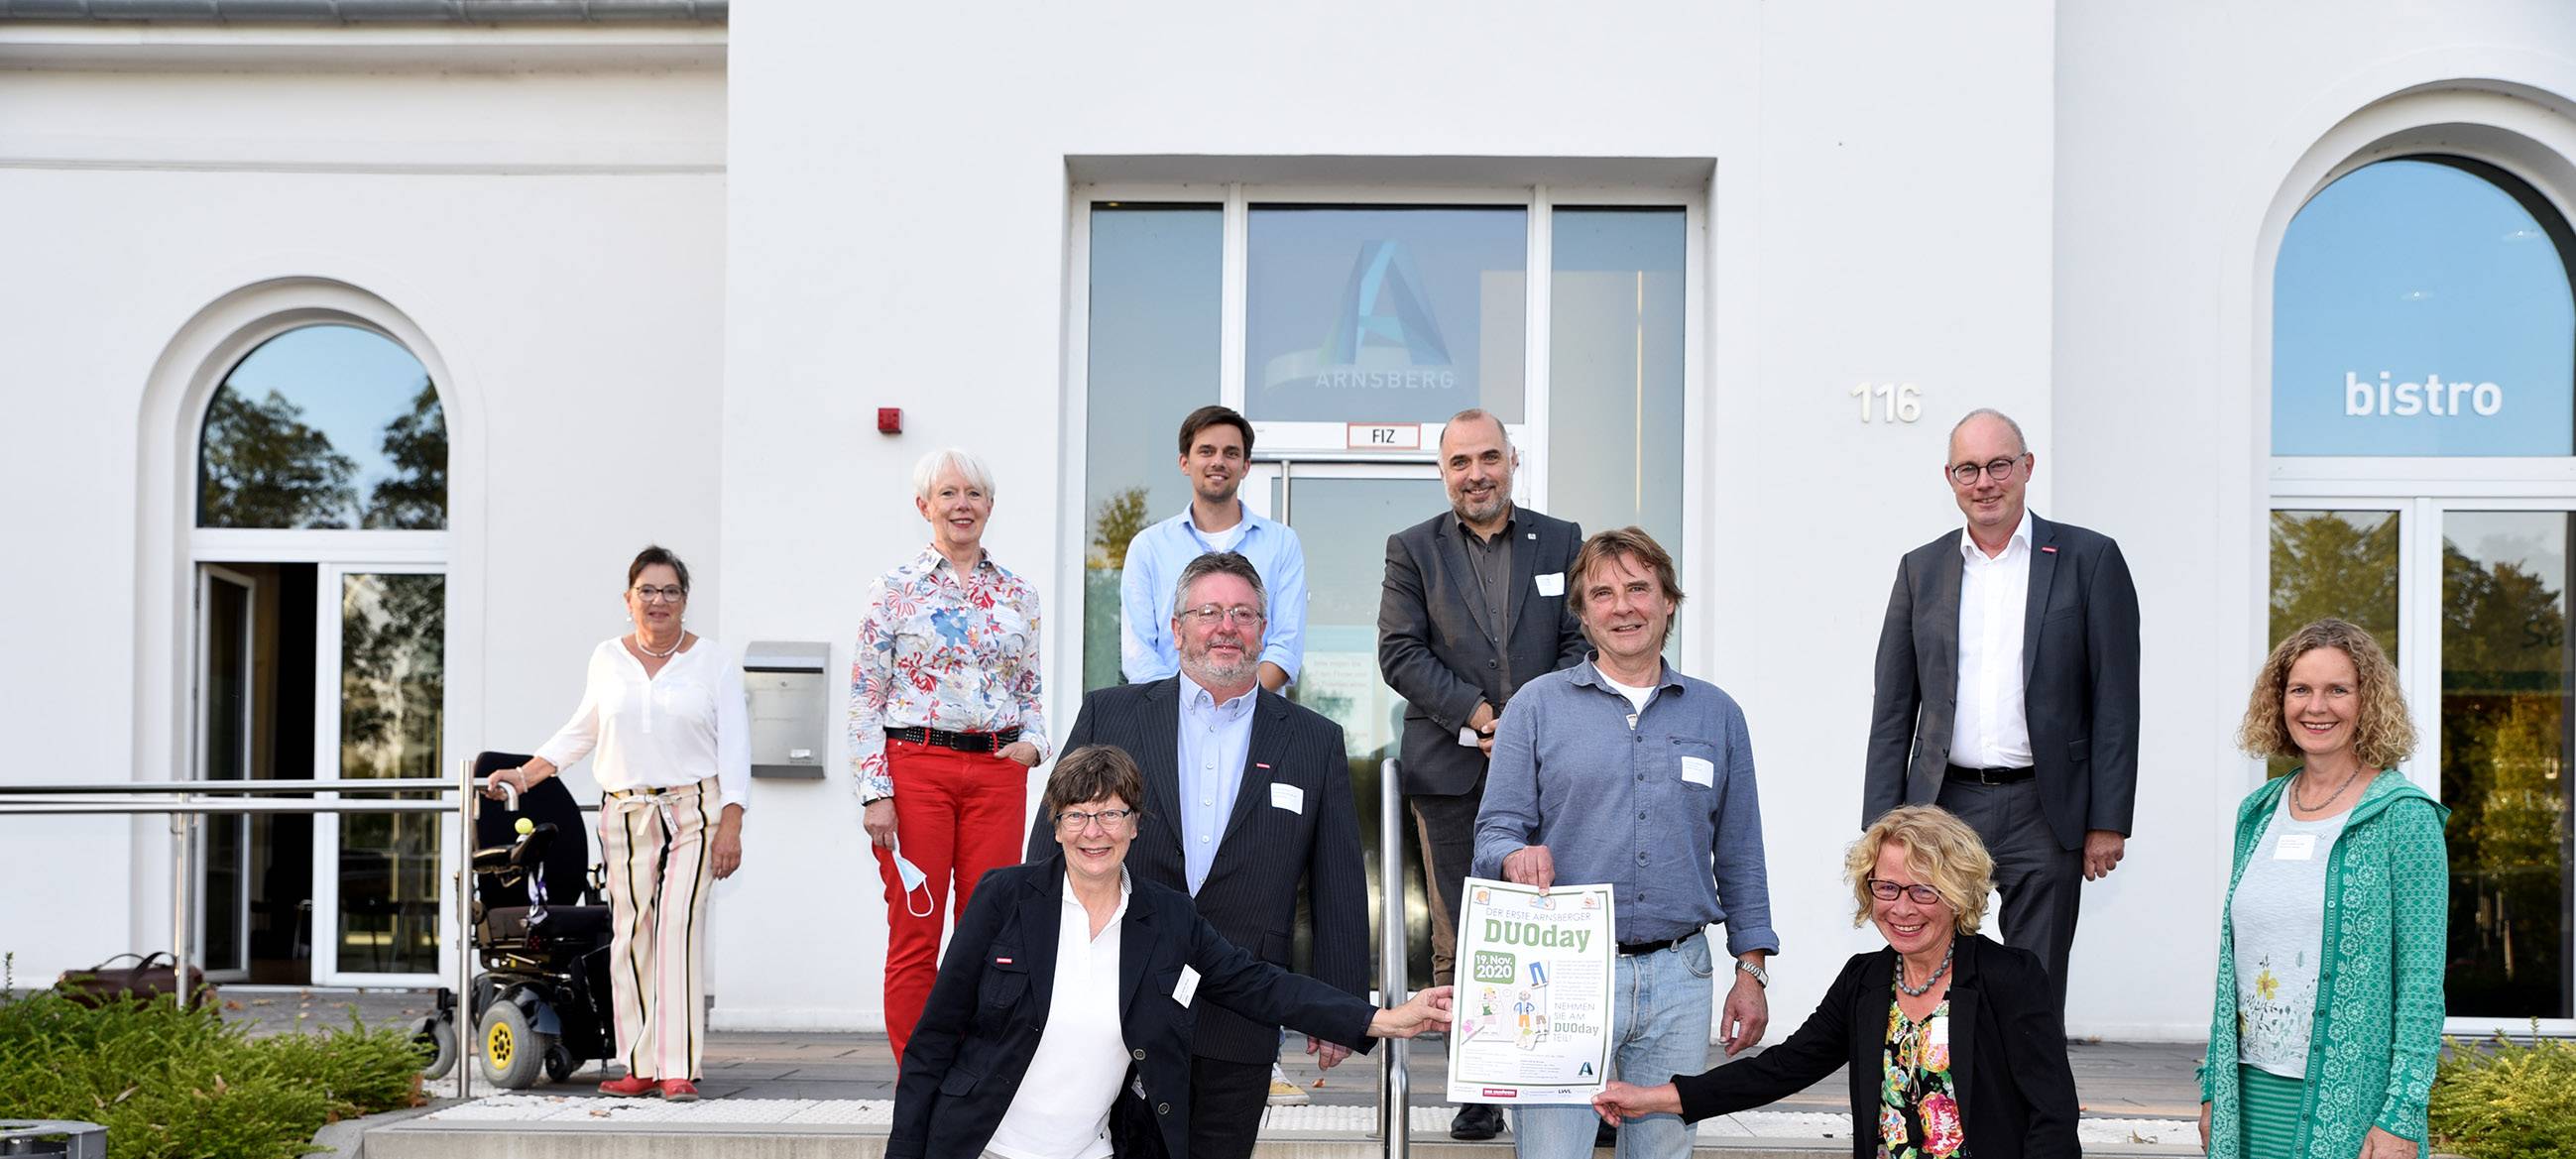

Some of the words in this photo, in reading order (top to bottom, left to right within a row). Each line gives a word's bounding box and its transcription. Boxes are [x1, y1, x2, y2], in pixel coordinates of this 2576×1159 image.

[1316, 371, 1455, 389] ARNSBERG
[2345, 371, 2503, 416] bistro
[1848, 381, 1923, 424] 116
[1372, 429, 1395, 443] FIZ
[1486, 907, 1503, 917] DER
[1506, 909, 1532, 920] ERSTE
[1533, 911, 1591, 922] ARNSBERGER
[1484, 918, 1591, 953] DUOday
[1475, 954, 1488, 965] 19.
[1490, 955, 1513, 966] Nov.
[1476, 965, 1513, 979] 2020
[1554, 1022, 1599, 1036] DUOday
